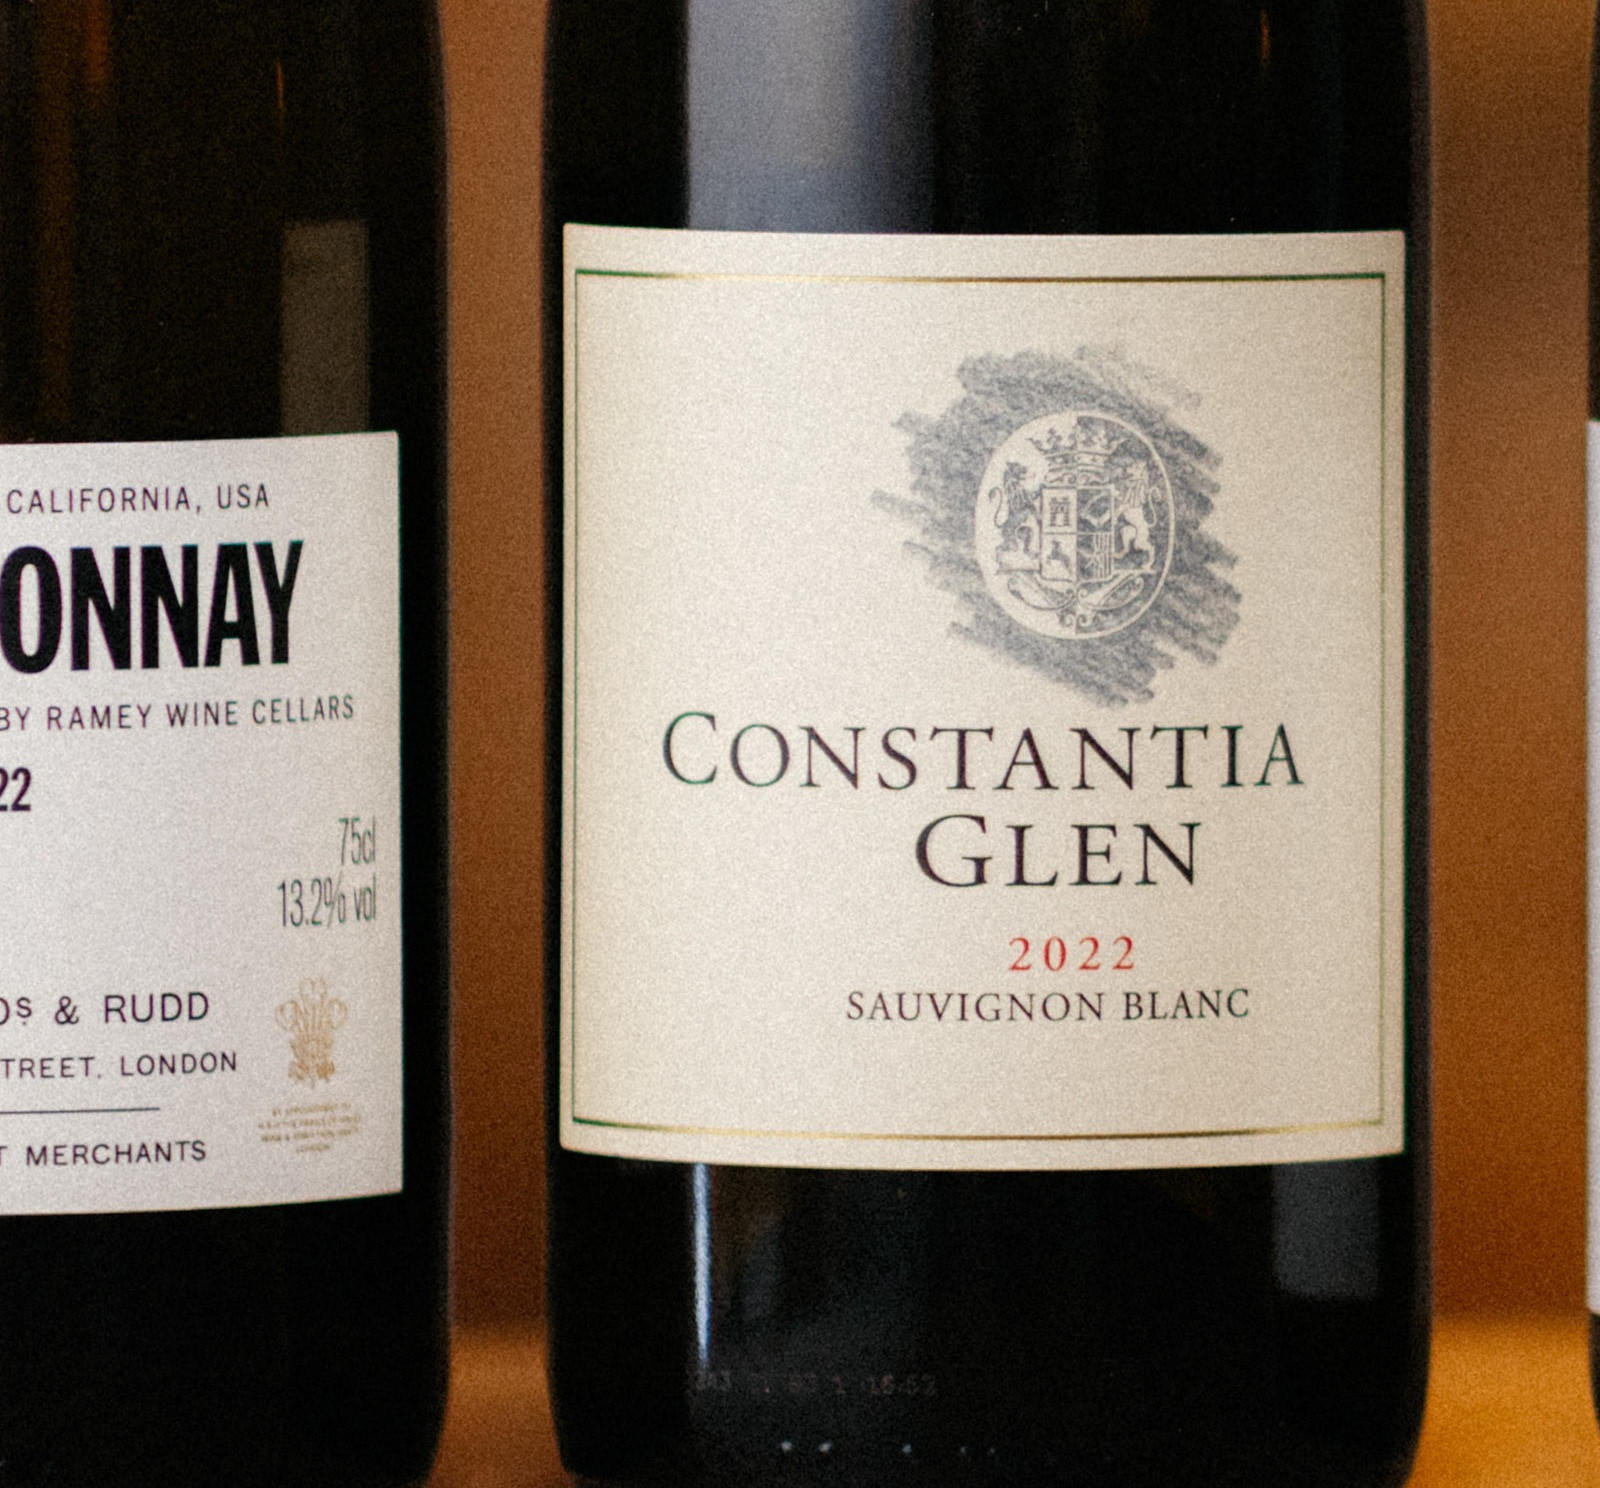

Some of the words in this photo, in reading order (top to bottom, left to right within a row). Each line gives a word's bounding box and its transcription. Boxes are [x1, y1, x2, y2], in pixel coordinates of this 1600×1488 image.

[7, 486, 201, 514] CALIFORNIA,
[217, 484, 269, 509] USA
[47, 704, 151, 729] RAMEY
[166, 701, 237, 727] WINE
[252, 694, 354, 725] CELLARS
[338, 815, 375, 865] 75cl
[278, 870, 346, 928] 13.2%
[354, 872, 376, 921] vol
[1009, 936, 1133, 971] 2022
[55, 997, 79, 1025] &
[105, 992, 209, 1023] RUDD
[847, 991, 1103, 1021] SAUVIGNON
[1124, 988, 1249, 1020] BLANC
[121, 1052, 236, 1076] LONDON
[26, 1140, 206, 1166] MERCHANTS
